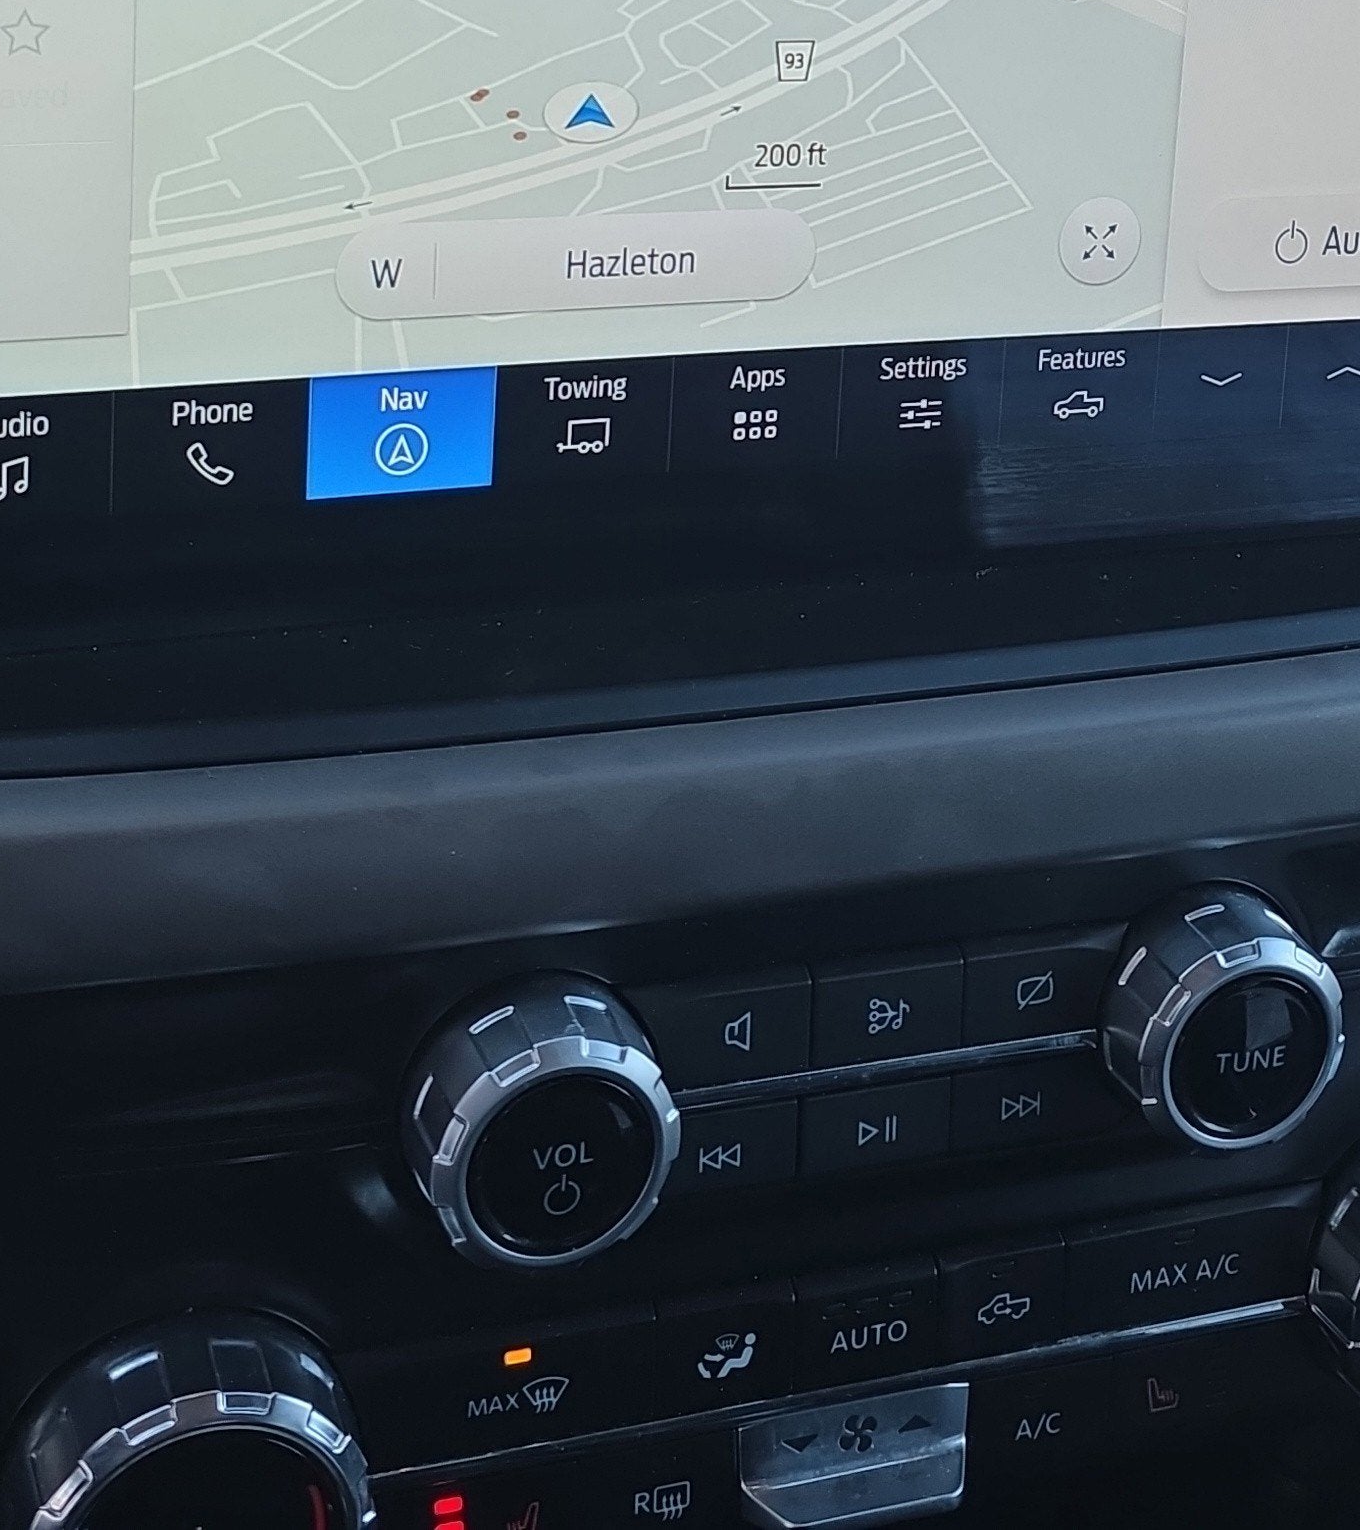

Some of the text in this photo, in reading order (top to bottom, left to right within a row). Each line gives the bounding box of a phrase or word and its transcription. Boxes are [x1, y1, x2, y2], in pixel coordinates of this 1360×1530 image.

[784, 52, 804, 70] 93
[754, 142, 827, 168] 200 ft
[371, 258, 403, 289] W
[567, 247, 695, 279] Hazleton
[879, 355, 967, 381] Settings
[1038, 348, 1126, 371] Features
[543, 374, 628, 401] Towing
[729, 365, 786, 393] Apps
[172, 399, 253, 427] Phone
[380, 387, 429, 412] Nav
[1216, 1045, 1286, 1074] TUNE
[533, 1141, 594, 1170] VOL
[1130, 1253, 1240, 1294] MAX A/C
[830, 1320, 908, 1354] AUTO
[467, 1392, 519, 1418] MAX
[1015, 1412, 1061, 1441] A/C
